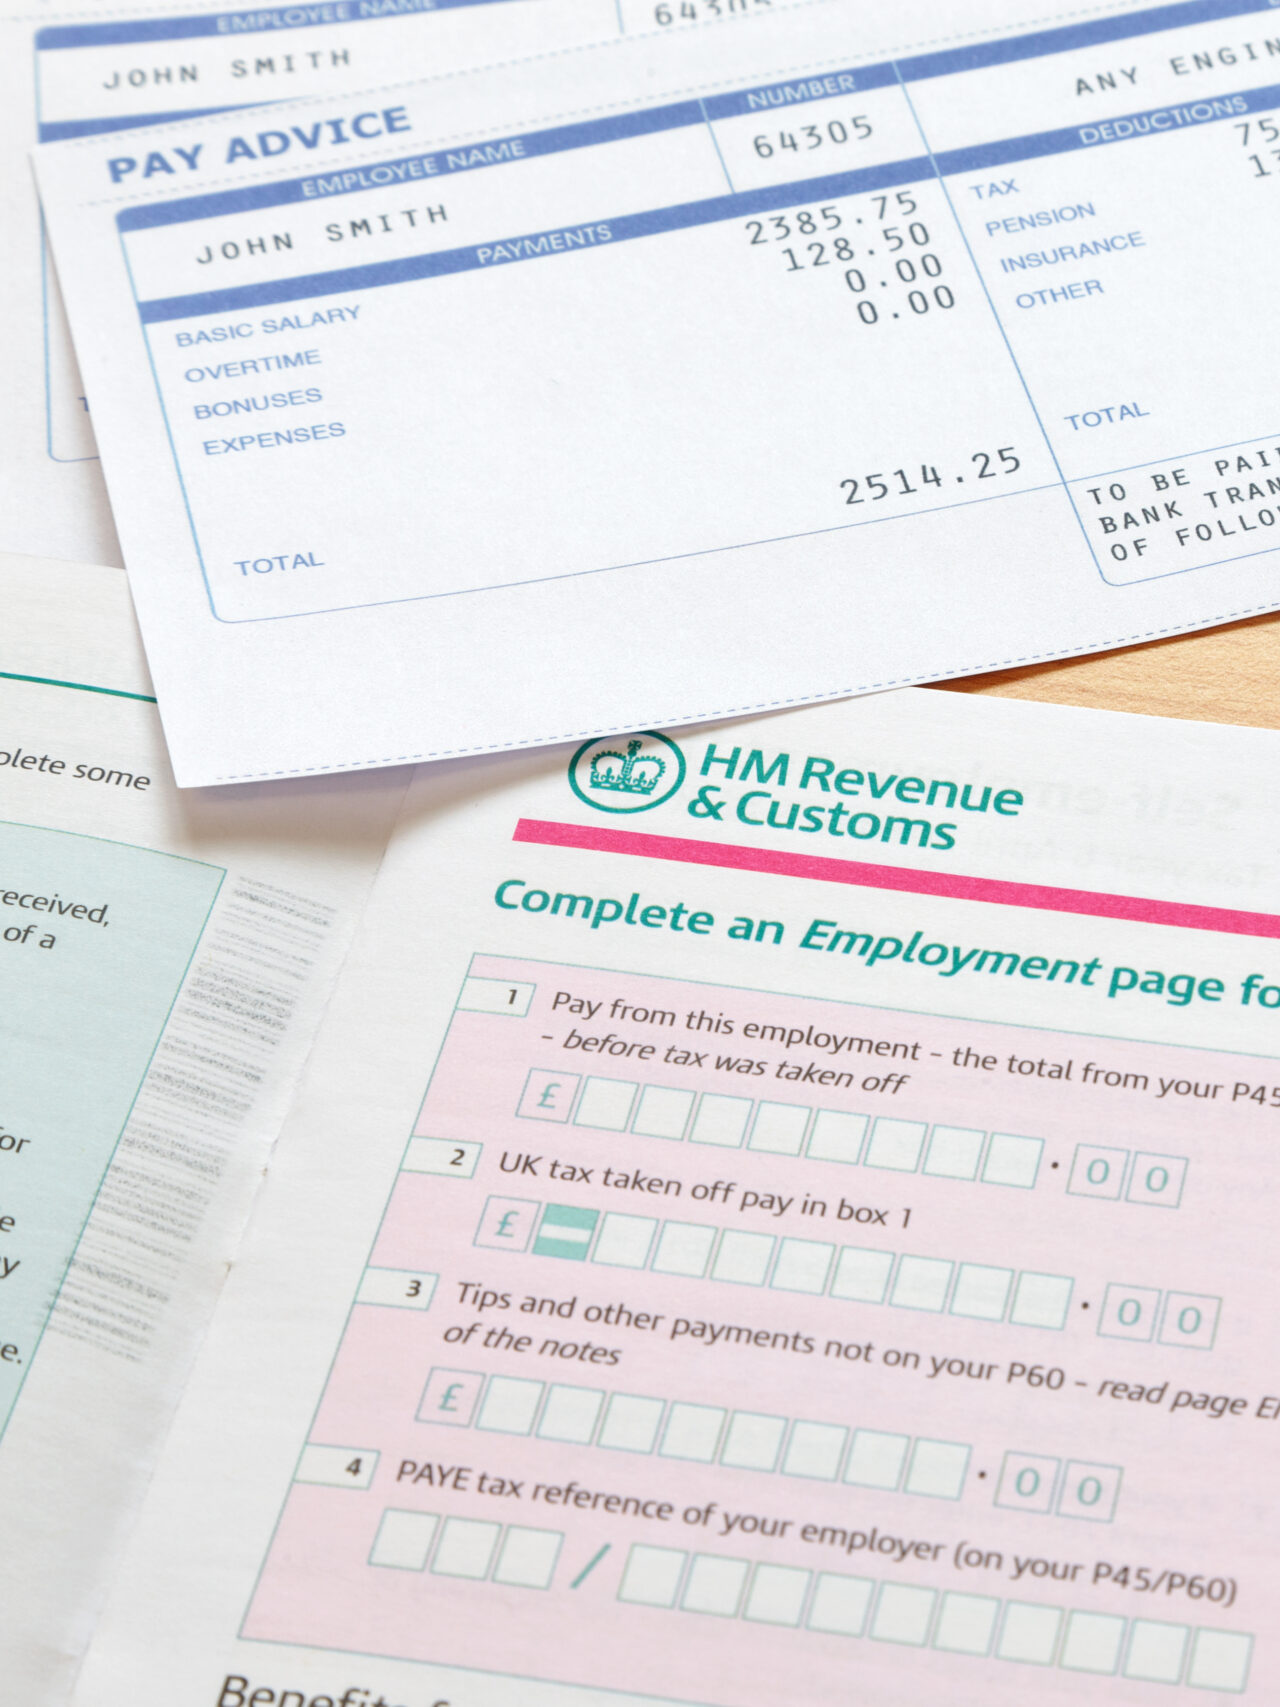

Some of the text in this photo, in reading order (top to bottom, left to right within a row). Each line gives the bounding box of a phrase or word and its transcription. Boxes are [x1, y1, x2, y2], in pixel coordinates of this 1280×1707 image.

[217, 0, 350, 33] EMPLOYEE
[103, 50, 352, 90] JOHN SMITH
[746, 74, 855, 109] NUMBER
[1074, 64, 1140, 97] ANY
[754, 114, 873, 159] 64305
[1079, 95, 1249, 146] DEDUCTIONS
[107, 105, 411, 183] PAY ADVICE
[302, 138, 526, 198] EMPLOYEE NAME
[970, 178, 1019, 201] TAX
[196, 204, 448, 264] JOHN SMITH
[985, 202, 1096, 237] PENSION
[477, 224, 611, 264] PAYMENTS
[1000, 231, 1146, 274] INSURANCE
[176, 189, 919, 347] BASIC SALARY 2385.75
[185, 221, 931, 383] OVERTIME 128.50
[1014, 279, 1104, 310] OTHER
[202, 284, 956, 455] EXPENSES 0.00
[194, 387, 323, 419] BONUSES
[1065, 401, 1150, 431] TOTAL
[1088, 482, 1127, 506] TO
[1152, 470, 1191, 491] BE
[234, 447, 1021, 577] TOTAL 2514.25
[1100, 500, 1183, 534] BANK
[1111, 538, 1150, 561] OF
[73, 763, 151, 791] some
[700, 743, 793, 787] HM
[799, 756, 1024, 816] Revenue
[687, 785, 957, 850] & Customs
[494, 879, 714, 934] Complete
[727, 916, 785, 945] an
[800, 920, 1102, 986] Employment
[1108, 965, 1224, 1006] page
[552, 992, 603, 1020] Pay
[610, 999, 676, 1027] from
[685, 1009, 736, 1035] this
[742, 1018, 920, 1061] employment
[952, 1046, 998, 1073] the
[1007, 1053, 1073, 1082] total
[1082, 1063, 1149, 1091] from
[1155, 1074, 1224, 1100] your
[563, 1028, 911, 1096] before tax was taken off
[499, 1151, 888, 1226] UK tax taken pay box
[457, 1282, 512, 1310] Tips
[519, 1297, 577, 1321] and
[583, 1304, 665, 1333] other
[671, 1316, 815, 1355] payments
[926, 1354, 1000, 1382] your
[1006, 1362, 1065, 1391] P60
[1098, 1377, 1170, 1404] read
[1170, 1387, 1247, 1418] page
[538, 1339, 623, 1368] notes
[396, 1459, 1239, 1604] PAYE tax reference your employer (on your P45/P60)
